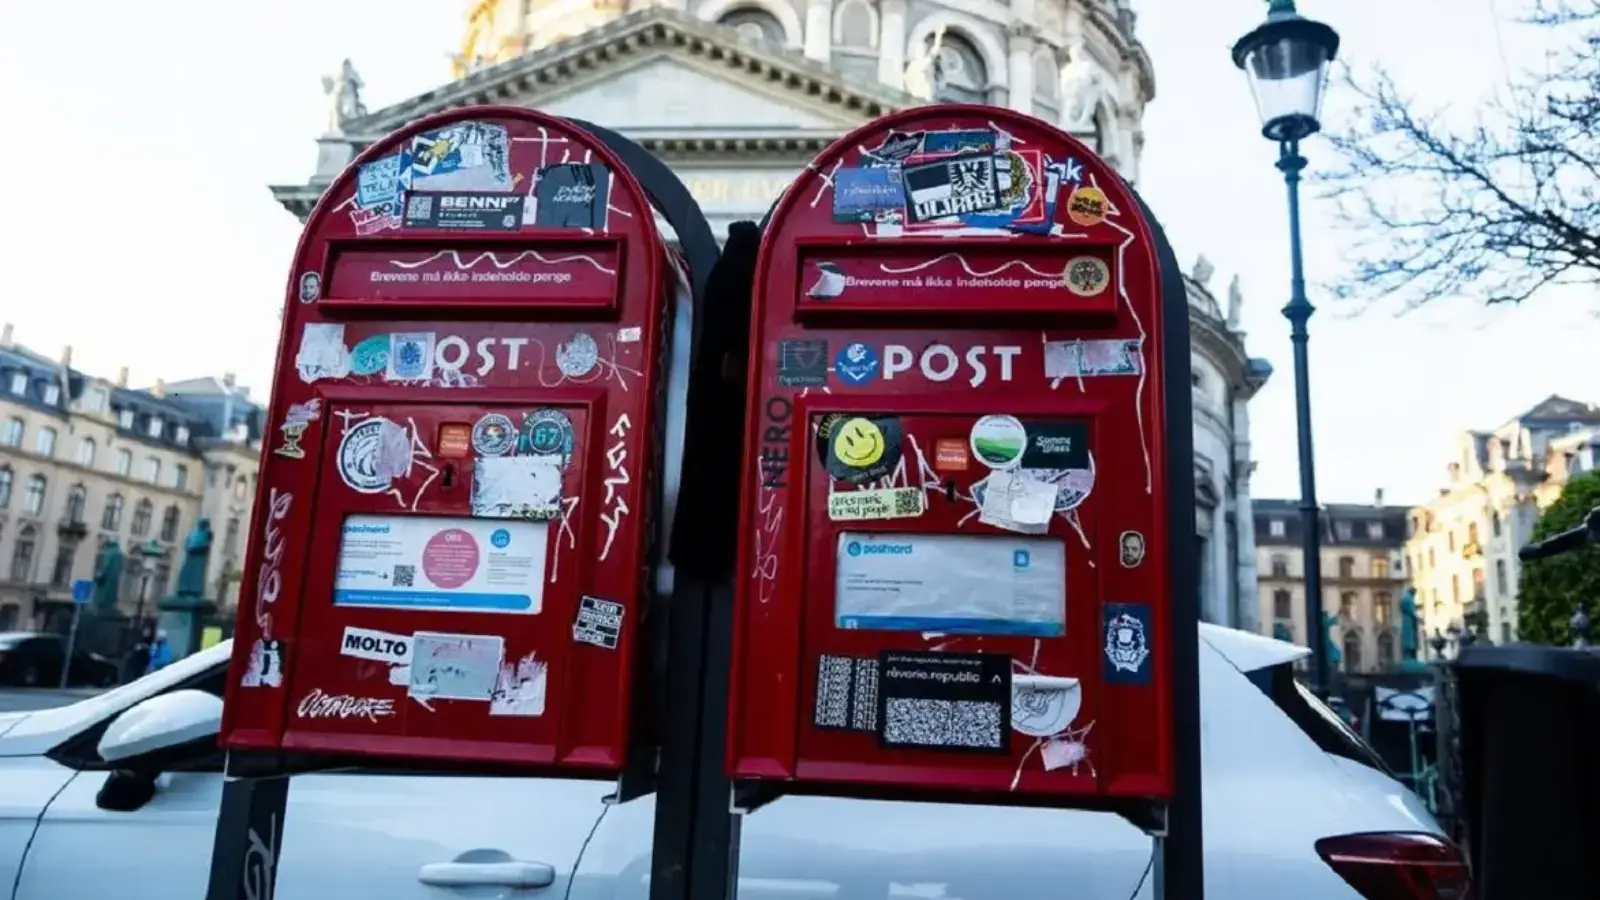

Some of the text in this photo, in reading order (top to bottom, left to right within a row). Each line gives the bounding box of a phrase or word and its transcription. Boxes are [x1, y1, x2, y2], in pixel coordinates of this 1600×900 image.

[370, 270, 571, 283] Brevene må ikke indeholde penge
[845, 276, 1065, 290] Brevene må ikke indeholde penge
[883, 344, 1022, 389] POST
[535, 428, 559, 446] 67
[863, 543, 913, 555] postnord
[345, 634, 408, 657] MOLTO
